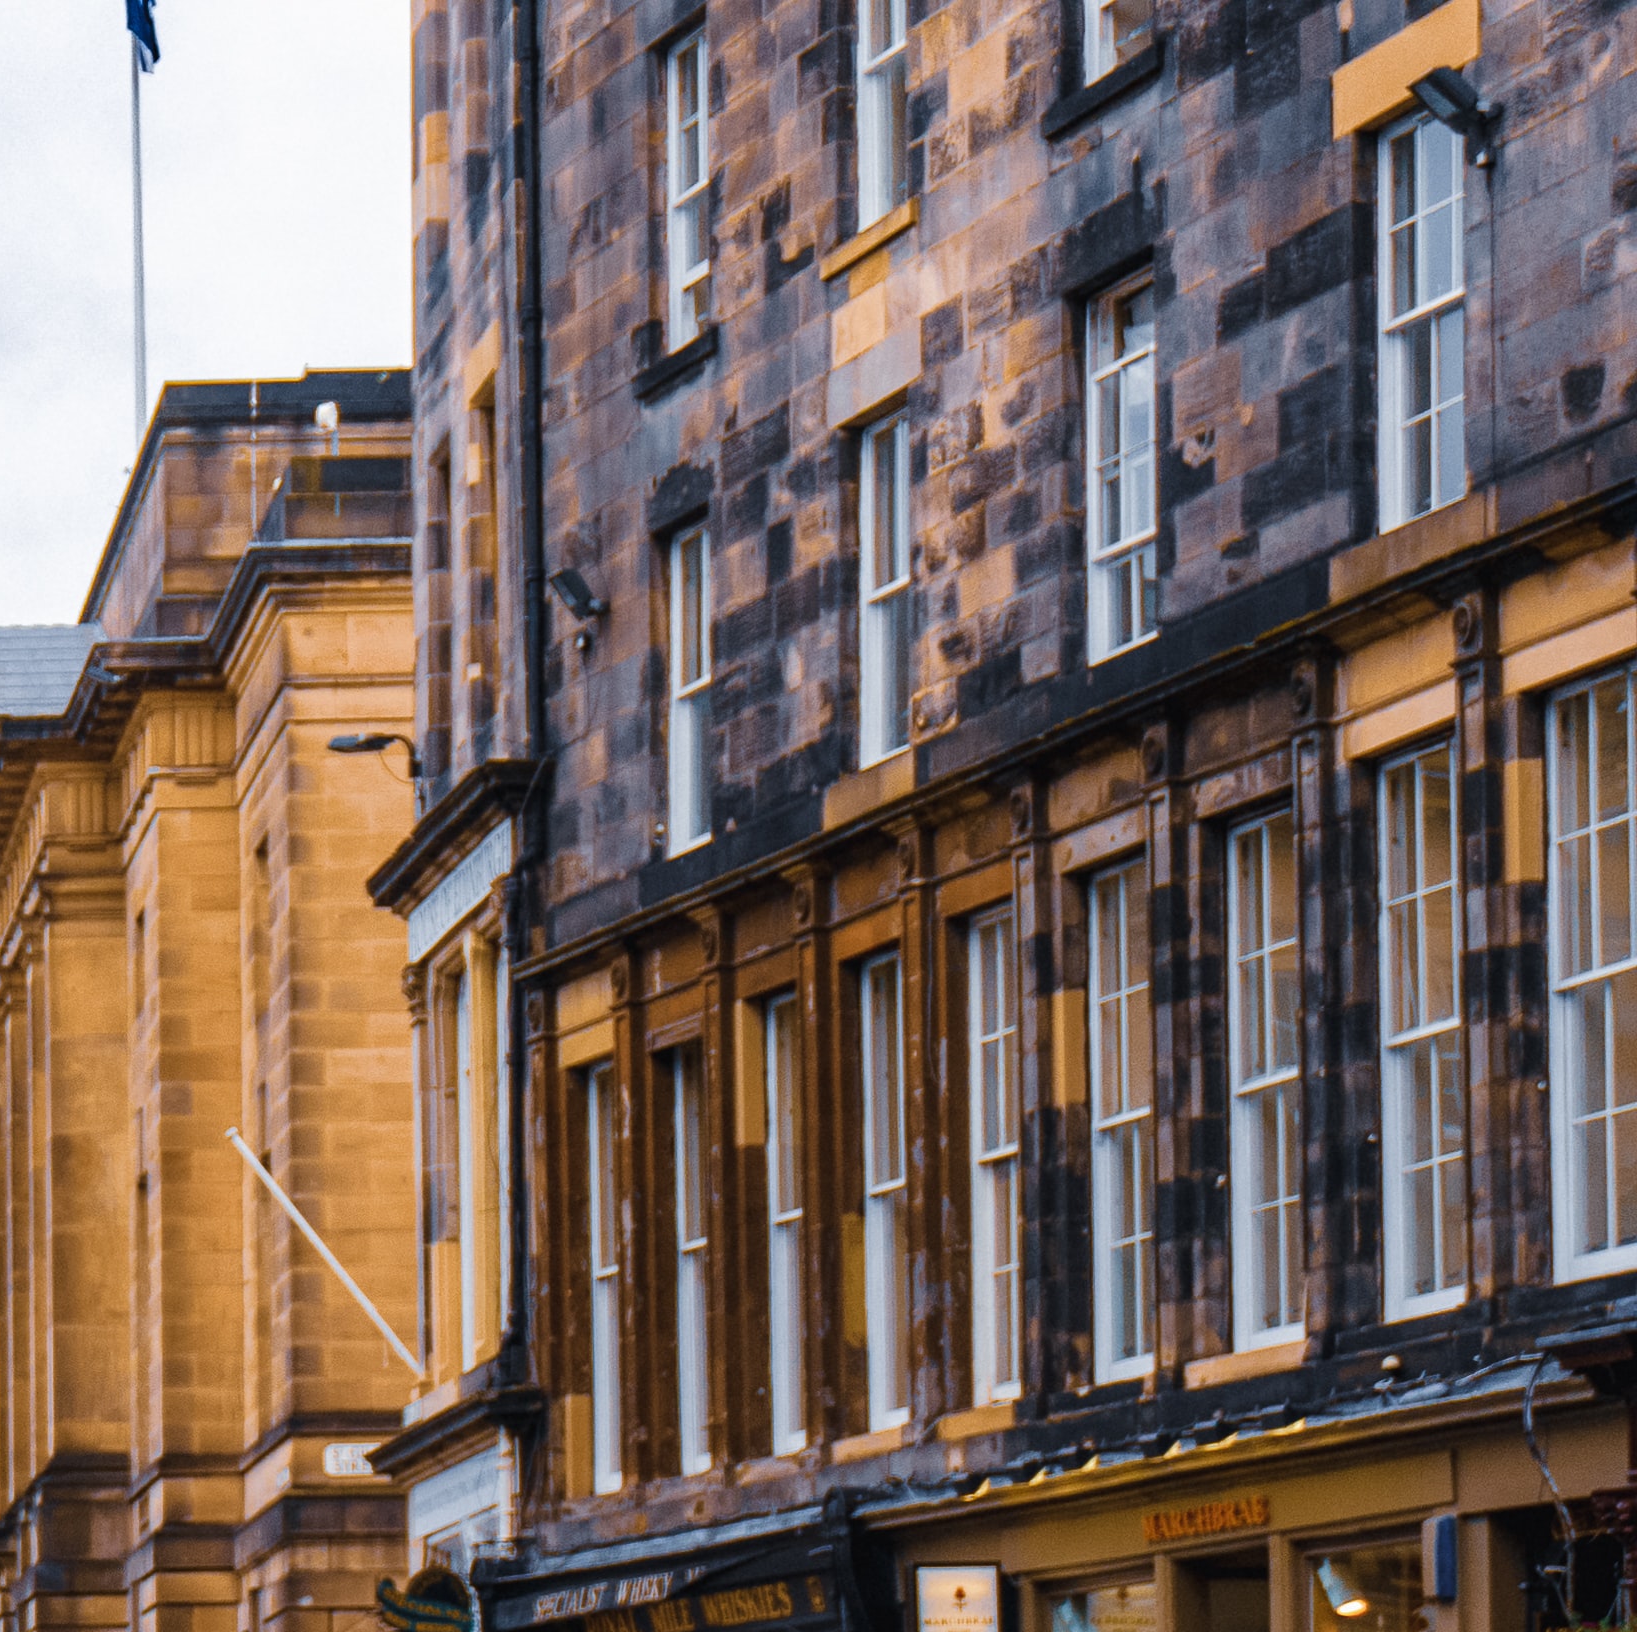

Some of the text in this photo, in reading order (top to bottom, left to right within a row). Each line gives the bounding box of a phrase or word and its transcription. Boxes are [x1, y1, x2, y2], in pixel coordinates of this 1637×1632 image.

[1142, 1495, 1269, 1541] MARCHBRAE
[533, 1581, 609, 1622] SPECIALIST
[616, 1571, 675, 1606] WHISKY
[701, 1581, 794, 1628] WHISKIES
